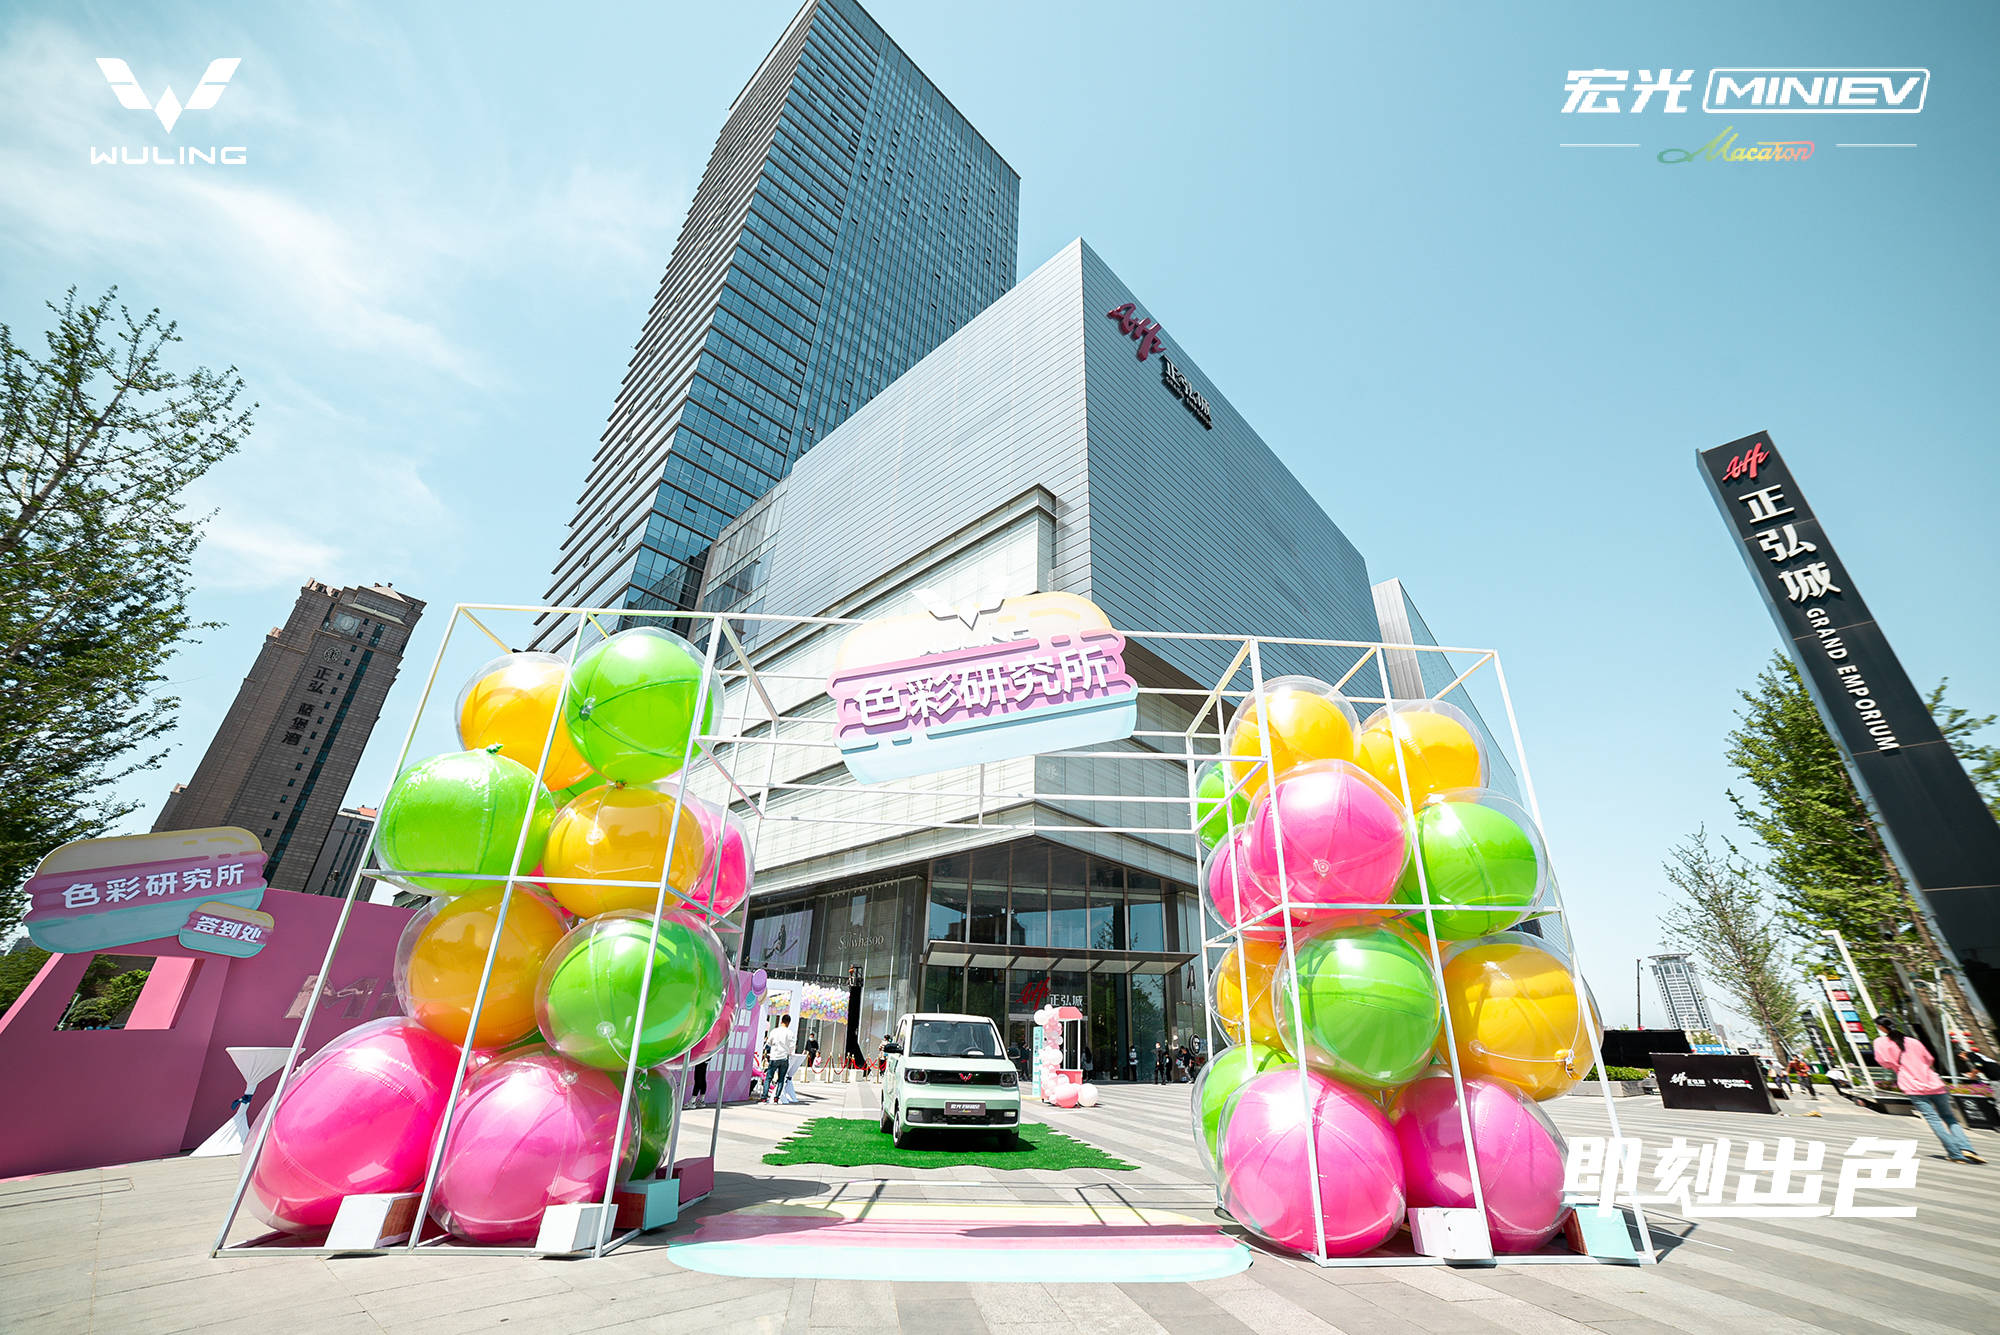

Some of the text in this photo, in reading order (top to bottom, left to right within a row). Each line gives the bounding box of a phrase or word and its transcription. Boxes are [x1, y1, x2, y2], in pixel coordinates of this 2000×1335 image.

[1737, 484, 1841, 602] 正弘城
[855, 645, 1108, 727] 色彩研究所
[1805, 606, 1900, 752] GRAND EMPORIUM
[62, 863, 245, 909] 色彩研究所
[193, 915, 263, 944] 签到处
